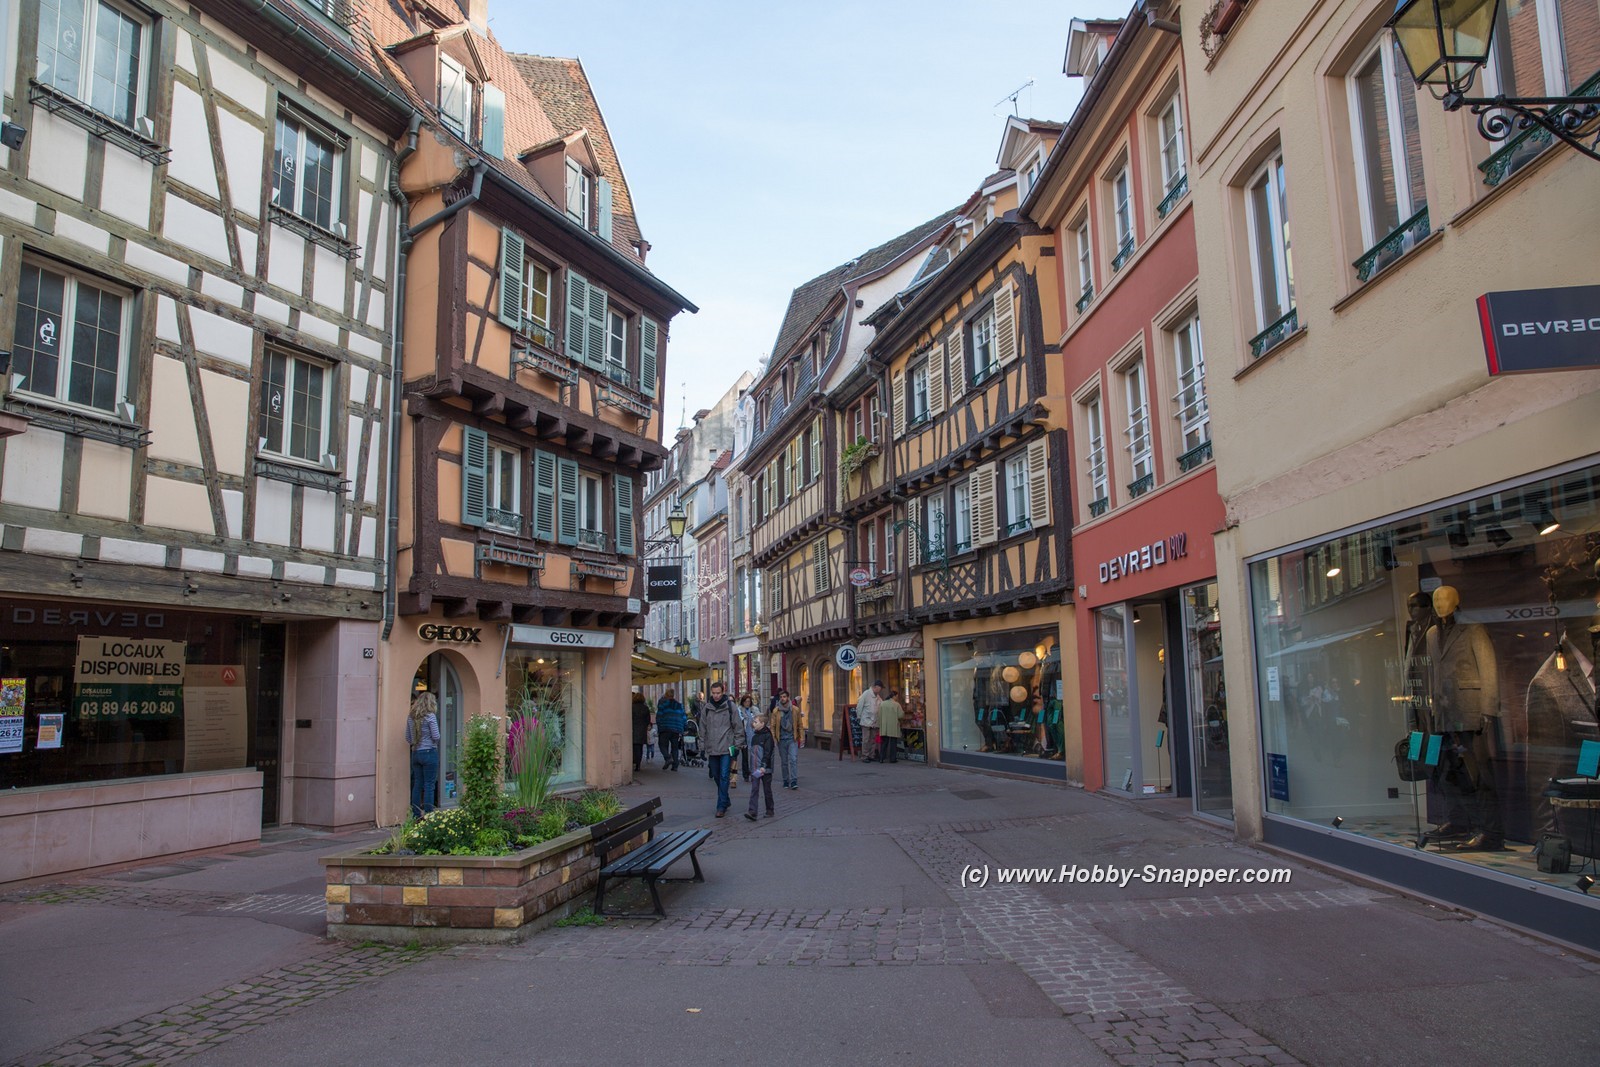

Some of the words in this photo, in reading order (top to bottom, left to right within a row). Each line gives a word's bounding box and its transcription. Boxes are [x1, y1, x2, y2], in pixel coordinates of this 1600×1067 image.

[1099, 540, 1167, 584] DEVRED
[649, 579, 678, 588] GEOX
[418, 623, 482, 644] GEOX
[550, 631, 584, 645] GEOX
[102, 642, 165, 658] LOCAUX
[364, 648, 374, 657] 20
[81, 660, 181, 676] DISPONIBLES
[81, 702, 98, 715] 03
[102, 701, 119, 714] 89
[122, 701, 138, 714] 46
[141, 701, 157, 714] 20
[159, 701, 175, 714] 80
[0, 729, 11, 737] 26
[12, 729, 22, 737] 27
